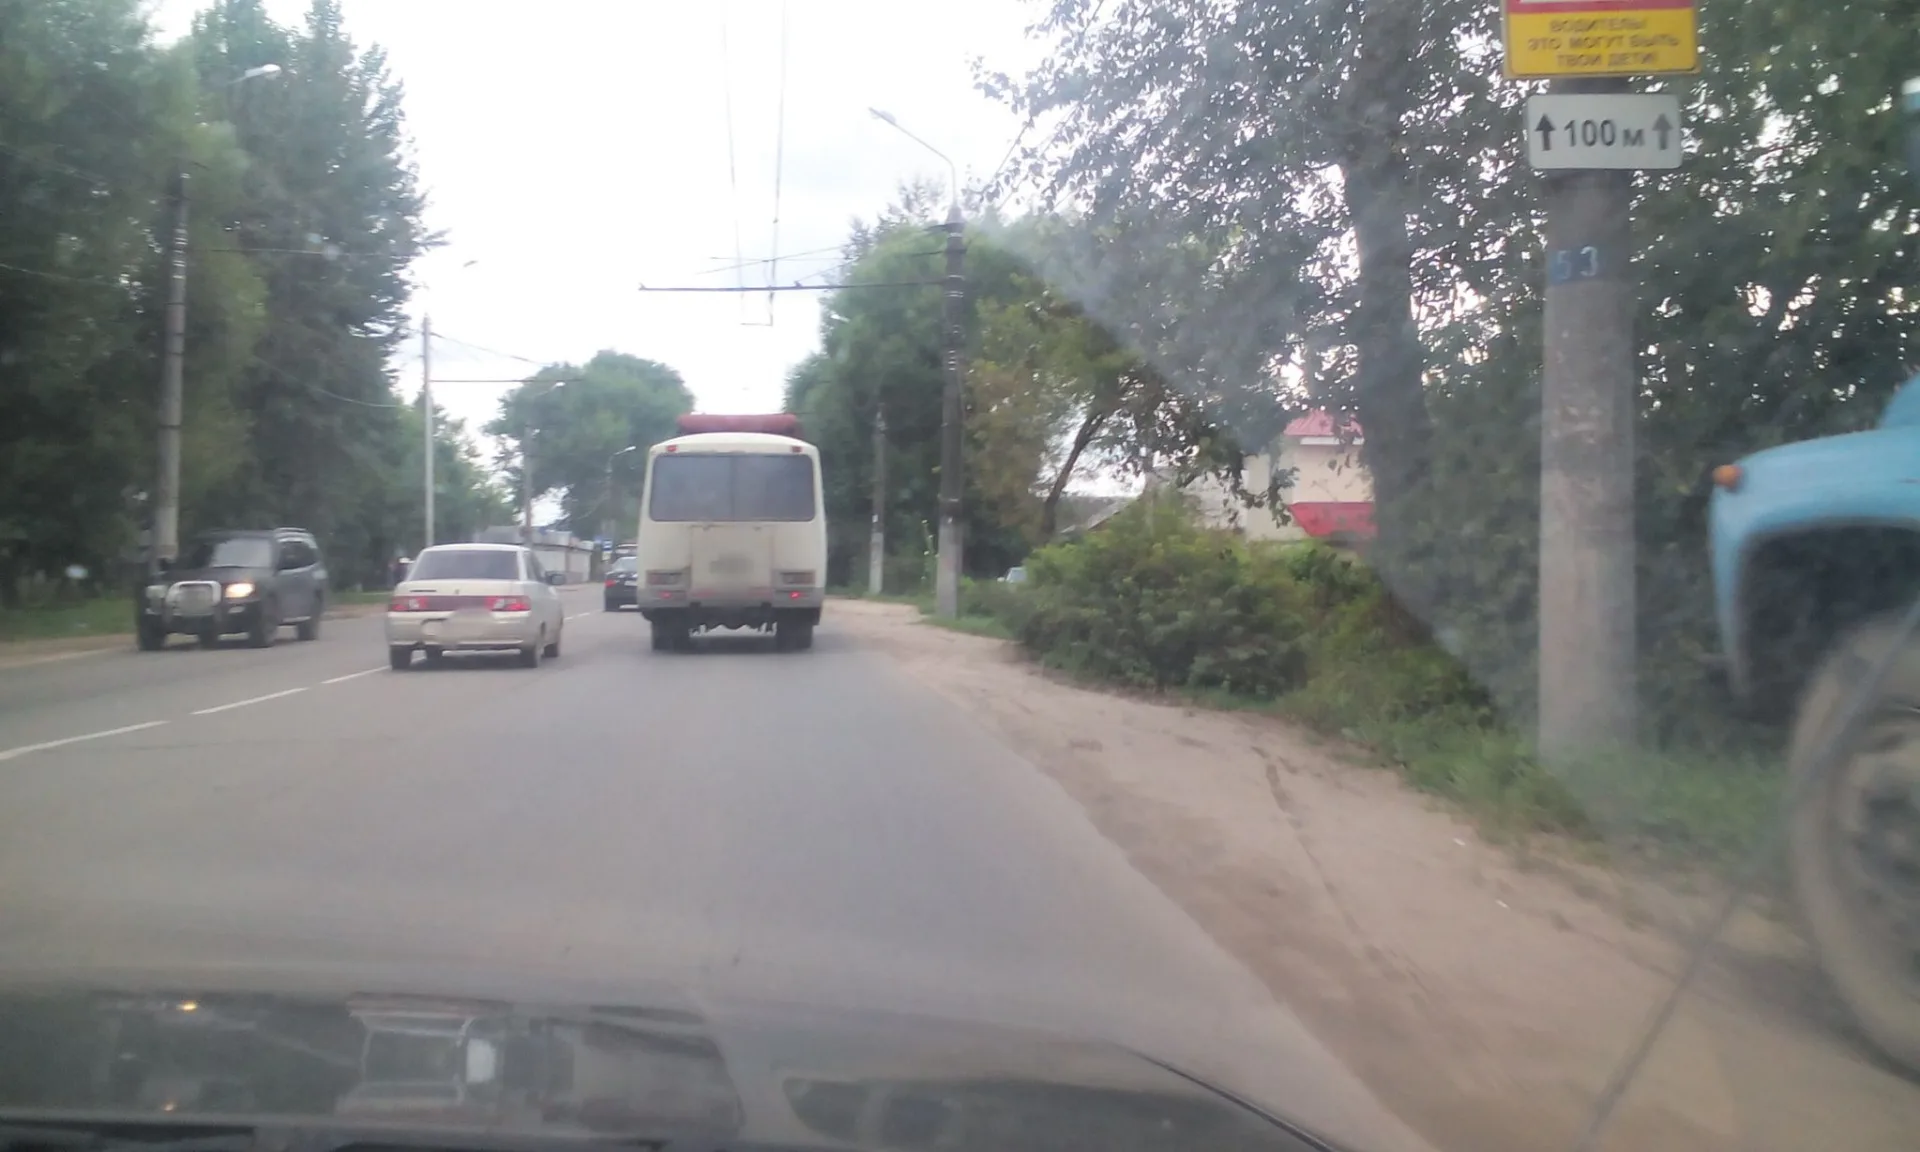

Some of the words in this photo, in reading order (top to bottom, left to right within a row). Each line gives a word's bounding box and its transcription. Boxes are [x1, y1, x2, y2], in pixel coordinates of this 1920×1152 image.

[1527, 36, 1560, 51] ЭТО
[1569, 35, 1624, 49] МОГУТ
[1629, 33, 1680, 48] БЫТЬ
[1557, 53, 1602, 67] ТВОИ
[1563, 119, 1616, 147] 100
